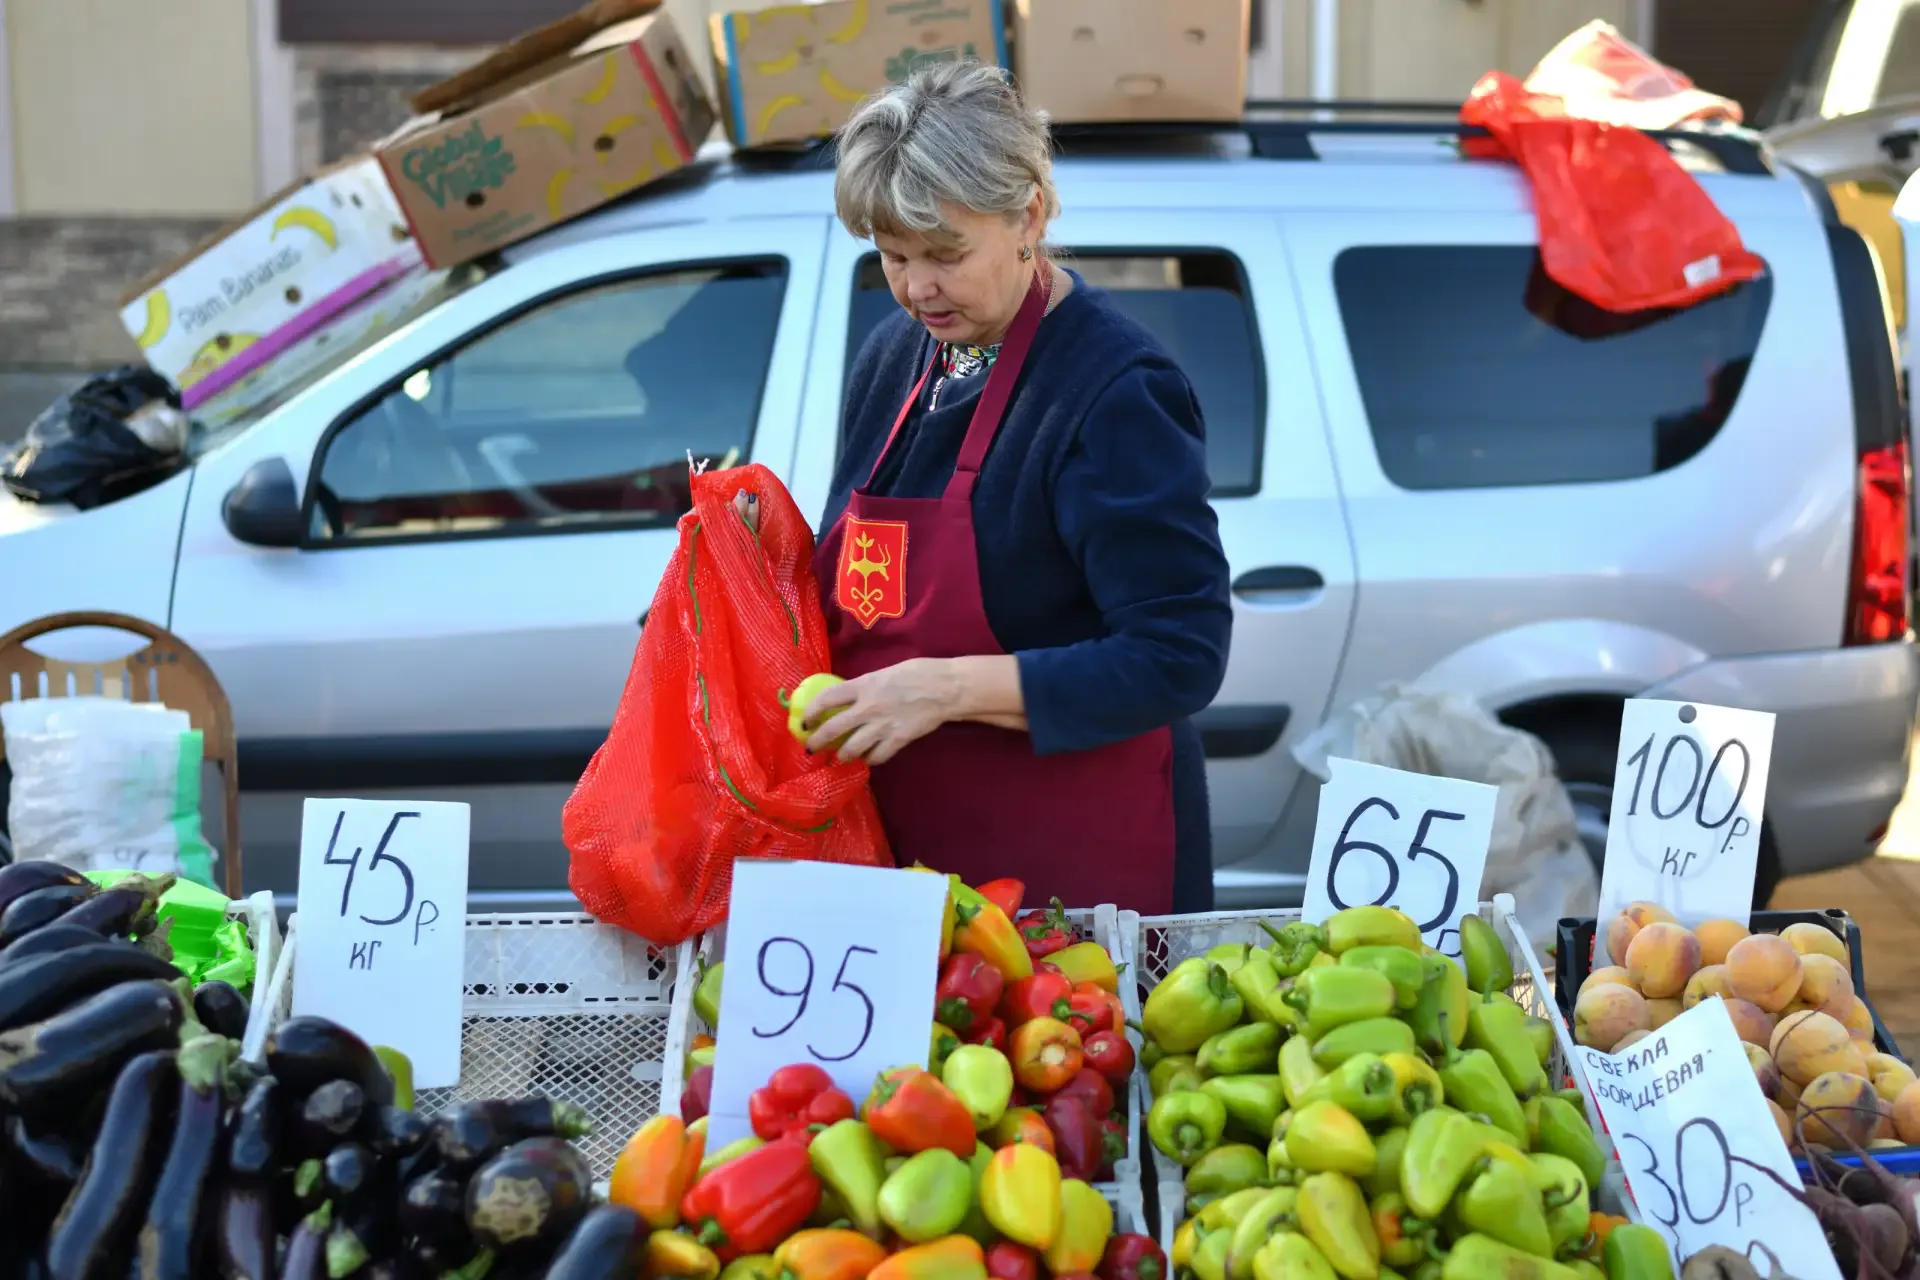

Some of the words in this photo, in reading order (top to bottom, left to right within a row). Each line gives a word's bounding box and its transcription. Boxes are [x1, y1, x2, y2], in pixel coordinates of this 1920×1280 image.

[219, 246, 302, 305] Bananas
[1627, 732, 1750, 829] 100
[324, 811, 421, 926] 45
[1327, 796, 1466, 934] 65
[752, 936, 878, 1062] 95
[1586, 1036, 1669, 1078] СВЕКЛА
[1622, 1116, 1732, 1227] 30
